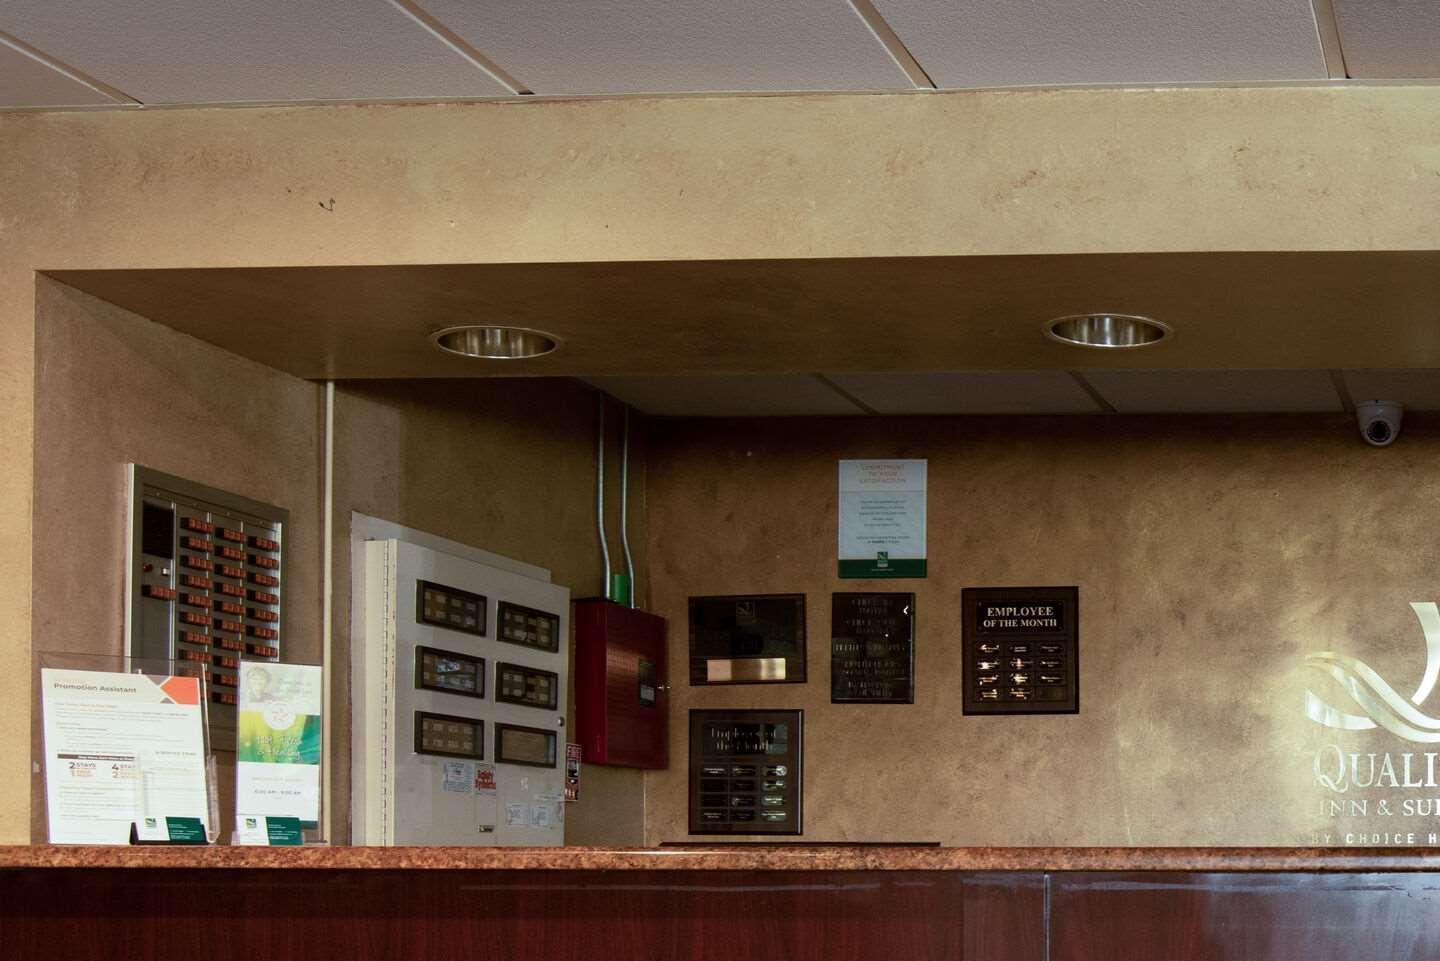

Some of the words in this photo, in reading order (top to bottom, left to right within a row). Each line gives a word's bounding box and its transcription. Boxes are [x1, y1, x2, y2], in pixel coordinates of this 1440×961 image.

[987, 607, 1054, 617] EMPLOYEE
[983, 619, 996, 628] OF
[999, 619, 1018, 628] THE
[1020, 618, 1057, 627] MONTH
[54, 682, 98, 692] Promotion
[100, 685, 137, 694] Assistant
[1319, 799, 1368, 817] INN
[1376, 799, 1393, 816] &
[1345, 833, 1415, 844] CHOICE
